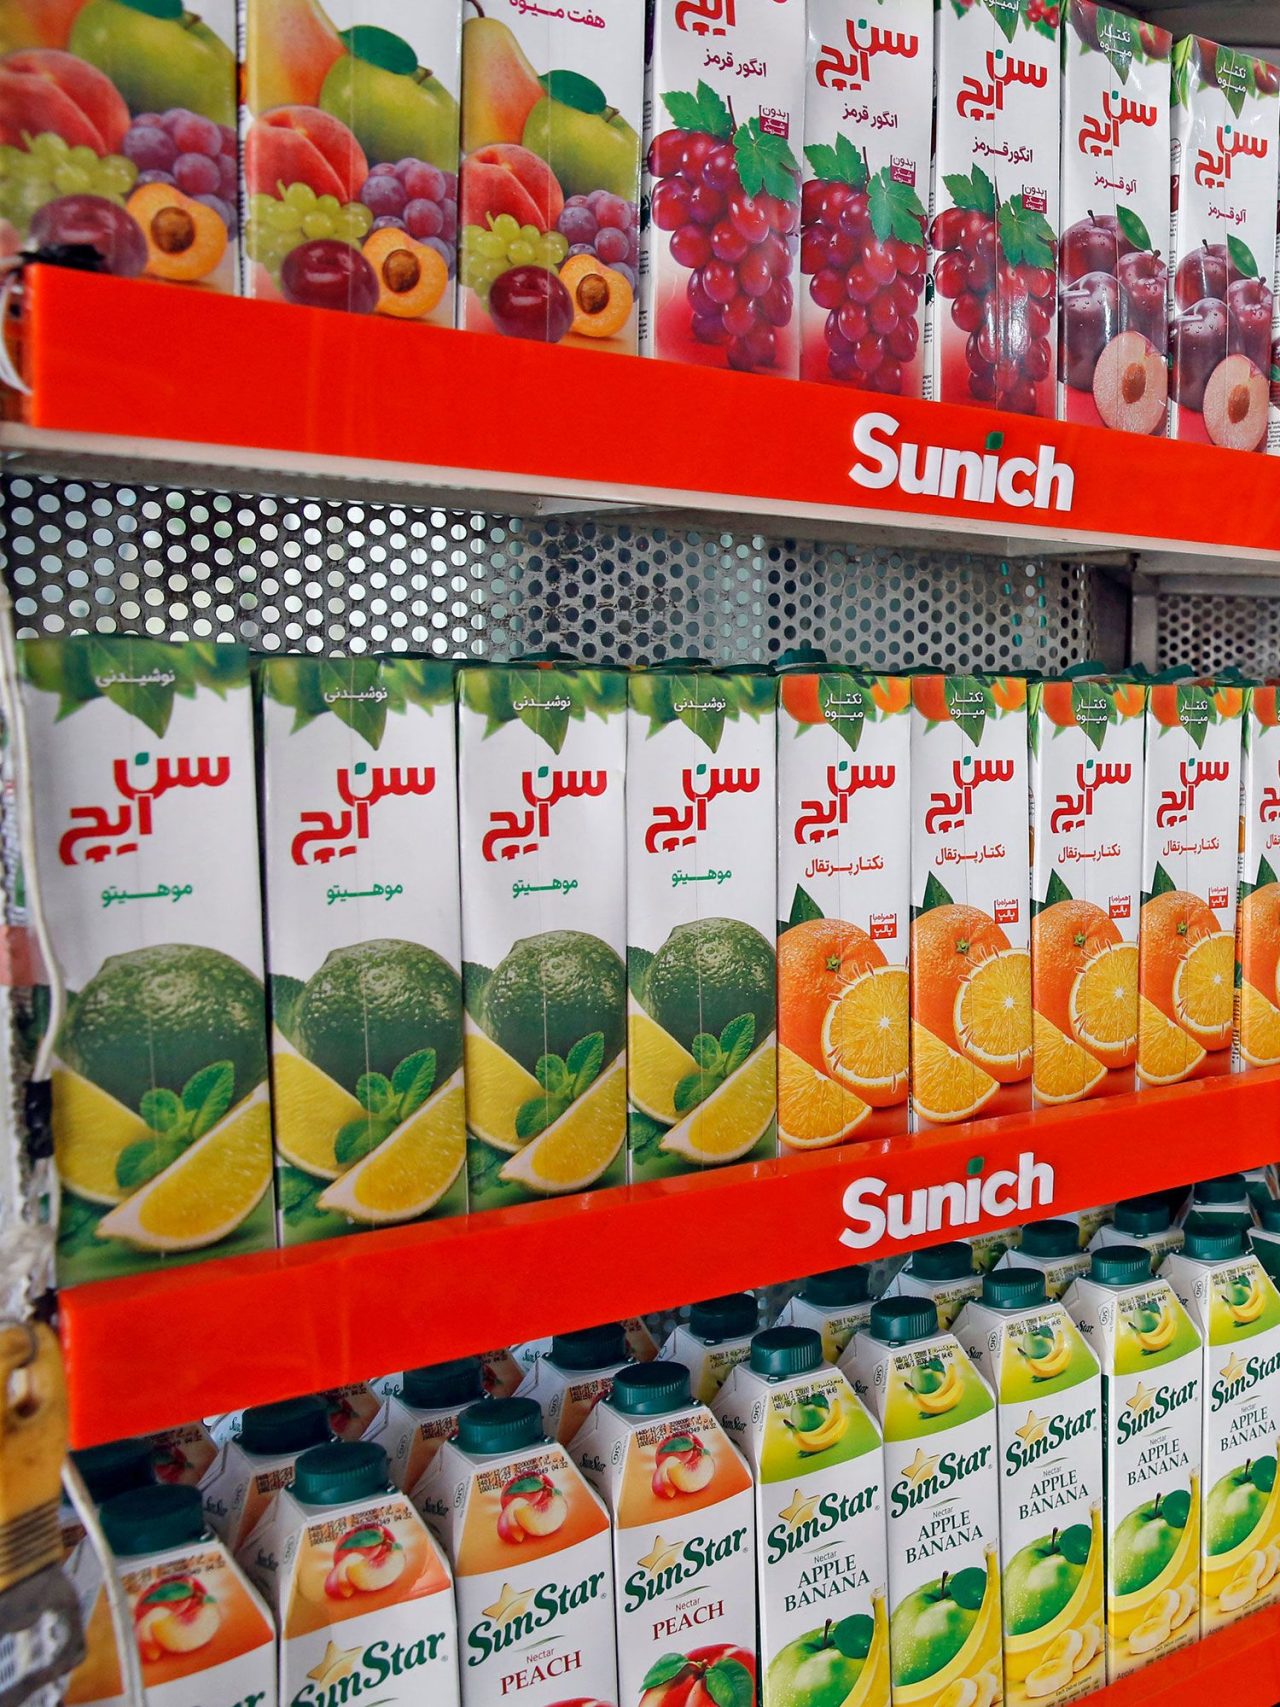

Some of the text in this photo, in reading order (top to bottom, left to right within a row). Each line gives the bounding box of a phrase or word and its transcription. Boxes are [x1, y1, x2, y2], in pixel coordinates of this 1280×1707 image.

[567, 9, 606, 29] هفت
[1100, 24, 1131, 43] نکتار
[845, 18, 919, 59] سن
[1099, 41, 1133, 59] میوه
[703, 48, 767, 77] انگور قرمز
[815, 44, 870, 91] ایچ
[986, 49, 1048, 89] سن
[1218, 60, 1247, 79] نکتار
[956, 75, 1004, 121] ایچ
[1217, 76, 1247, 94] میوه
[762, 107, 787, 120] بدون
[842, 102, 898, 129] انگور قرمز
[1102, 90, 1158, 127] سن
[972, 137, 1034, 163] انگور قرمز
[1078, 114, 1120, 156] ایچ
[1216, 124, 1269, 159] سن
[893, 156, 914, 169] بدون
[1194, 148, 1231, 189] ایچ
[1025, 186, 1045, 197] بدون
[1093, 170, 1138, 200] آلو قرمز
[1208, 201, 1247, 225] آلو قرمز
[848, 411, 1075, 512] Sunich
[95, 669, 176, 688] نوشیدنی
[323, 686, 388, 703] نوشیدنی
[512, 696, 572, 711] نوشیدنی
[673, 698, 727, 713] نوشیدنی
[824, 693, 862, 708] نکتار
[950, 690, 984, 706] نکتار
[1076, 698, 1107, 712] نکتار
[1180, 699, 1209, 712] نکتار
[824, 708, 864, 722] میوه
[950, 706, 985, 719] میوه
[1076, 714, 1108, 723] میوه
[1180, 714, 1209, 723] میوه
[113, 751, 230, 802] سن
[336, 762, 436, 807] سن
[522, 765, 608, 808] سن
[682, 763, 760, 804] سن
[827, 760, 896, 797] سن
[953, 755, 1014, 790] سن
[1076, 759, 1132, 792] سن
[1179, 758, 1229, 788] سن
[794, 793, 848, 844] ایچ
[924, 785, 972, 835] ایچ
[1051, 787, 1093, 834] ایچ
[1156, 784, 1195, 828] ایچ
[58, 794, 153, 867] ایچ
[290, 800, 370, 866] ایچ
[482, 802, 549, 862] ایچ
[645, 798, 706, 854] ایچ
[935, 844, 1006, 866] نکتار پرتقال
[1058, 843, 1122, 864] نکتار پرتقال
[1162, 837, 1220, 856] نکتار پرتقال
[671, 868, 733, 888] موهیتو
[804, 855, 885, 879] نکتار پرتقال
[101, 883, 194, 908] موهیتو
[326, 883, 404, 906] موهیتو
[511, 876, 579, 899] موهیتو
[874, 925, 893, 937] پالپ
[998, 910, 1015, 922] پالپ
[838, 1151, 1055, 1249] Sunich
[1117, 1377, 1198, 1447] SunStar
[1229, 1406, 1268, 1433] APPLE
[1005, 1407, 1097, 1478] SunStar
[1220, 1421, 1277, 1452] BANANA
[1136, 1438, 1181, 1467] APPLE
[891, 1444, 992, 1519] SunStar
[1127, 1451, 1190, 1487] BANANA
[1029, 1469, 1079, 1500] APPLE
[932, 1505, 954, 1519] Nectar
[1018, 1483, 1090, 1520] BANANA
[767, 1484, 879, 1565] SunStar
[917, 1509, 972, 1542] APPLE
[813, 1550, 838, 1564] Nectar
[905, 1524, 984, 1564] BANANA
[623, 1527, 748, 1614] SunStar
[797, 1553, 857, 1588] APPLE
[675, 1597, 702, 1612] Nectar
[783, 1569, 871, 1612] BANANA
[467, 1571, 604, 1667] SunStar
[652, 1600, 725, 1641] PEACH
[526, 1648, 555, 1664] Nectar
[500, 1650, 583, 1696] PEACH
